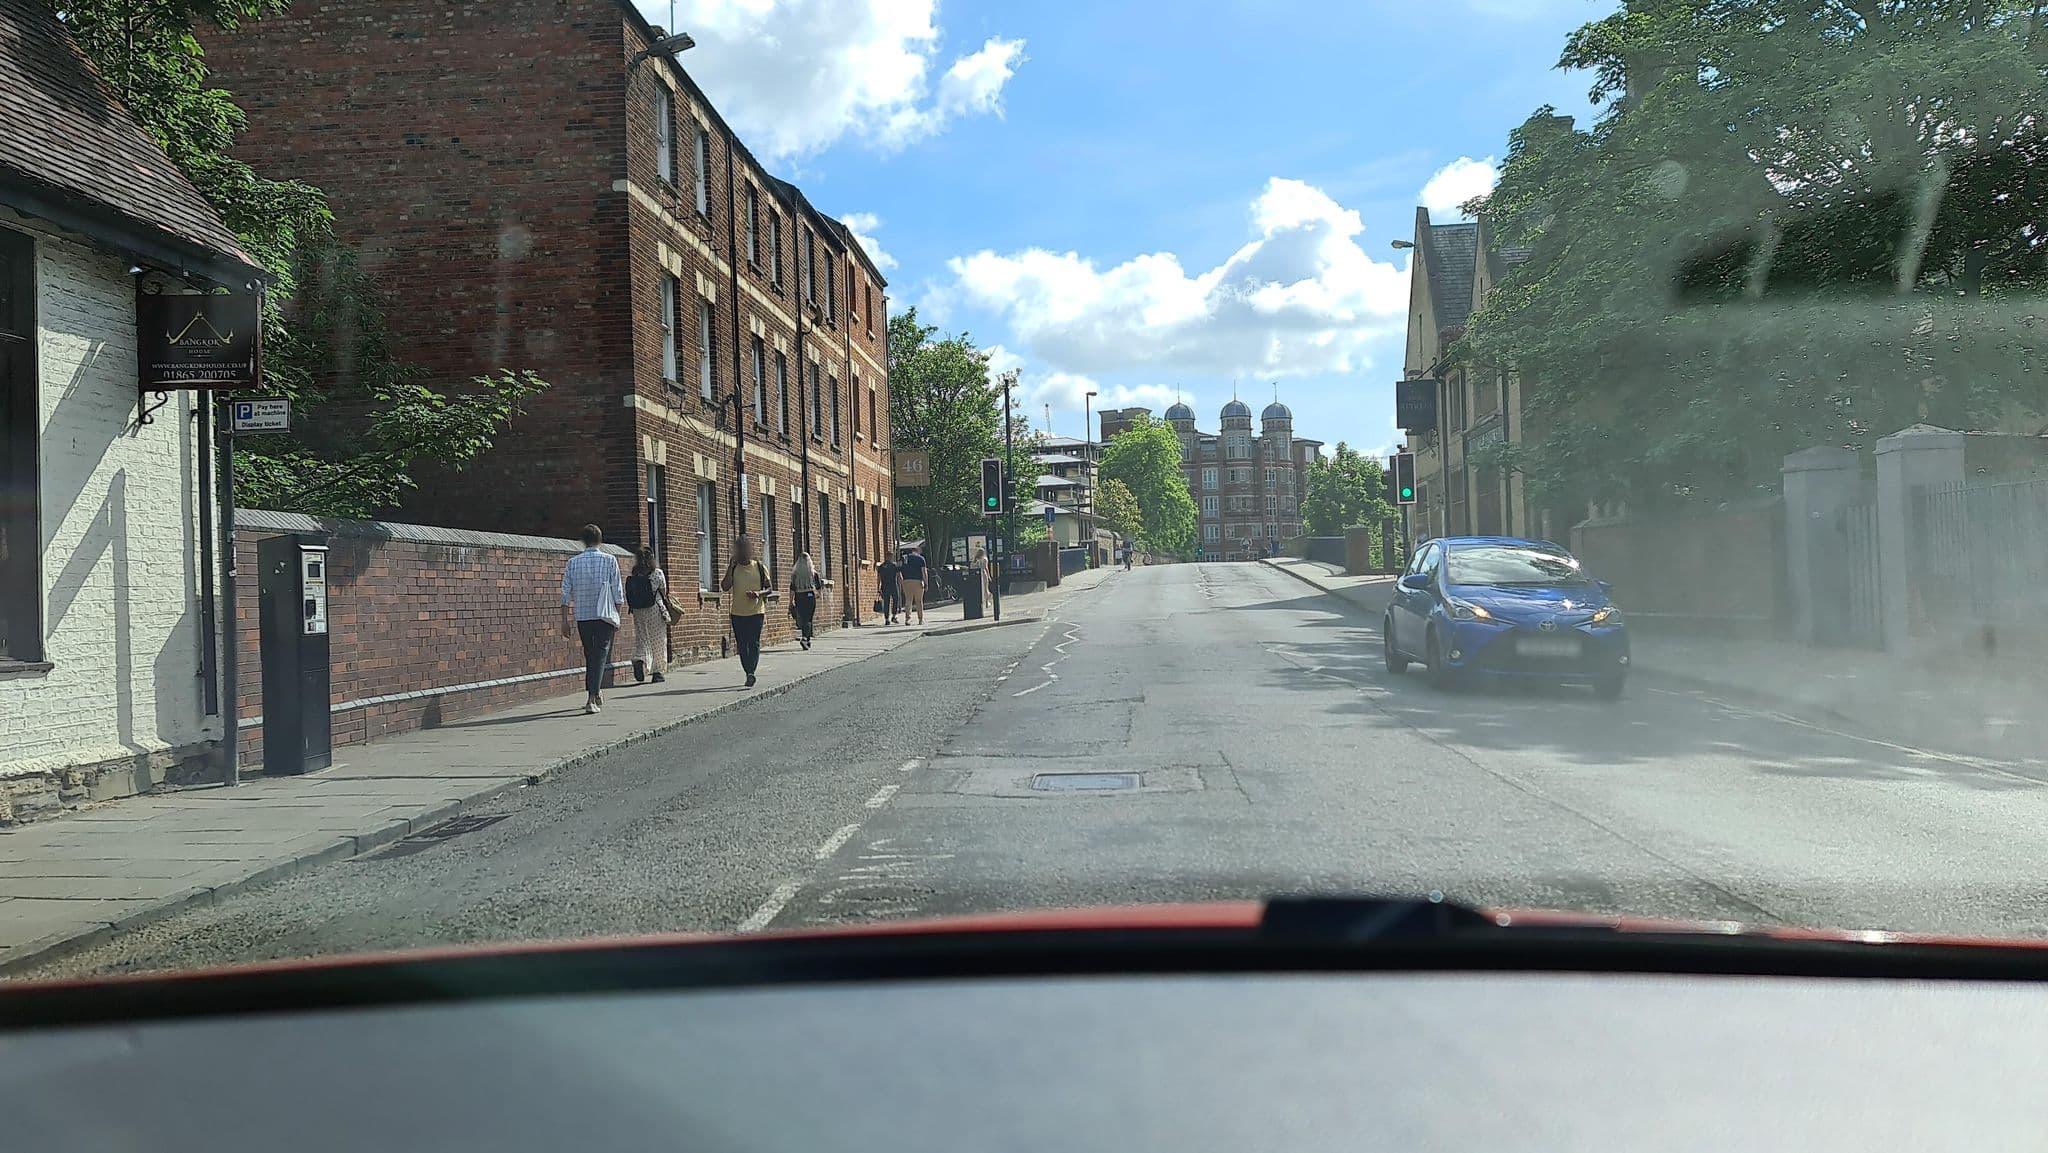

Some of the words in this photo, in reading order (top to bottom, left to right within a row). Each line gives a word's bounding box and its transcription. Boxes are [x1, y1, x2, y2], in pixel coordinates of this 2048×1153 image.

[179, 338, 222, 347] BANGKOK
[163, 370, 195, 380] 01865
[199, 370, 237, 380] 200705
[240, 405, 250, 419] P
[902, 459, 923, 472] 46
